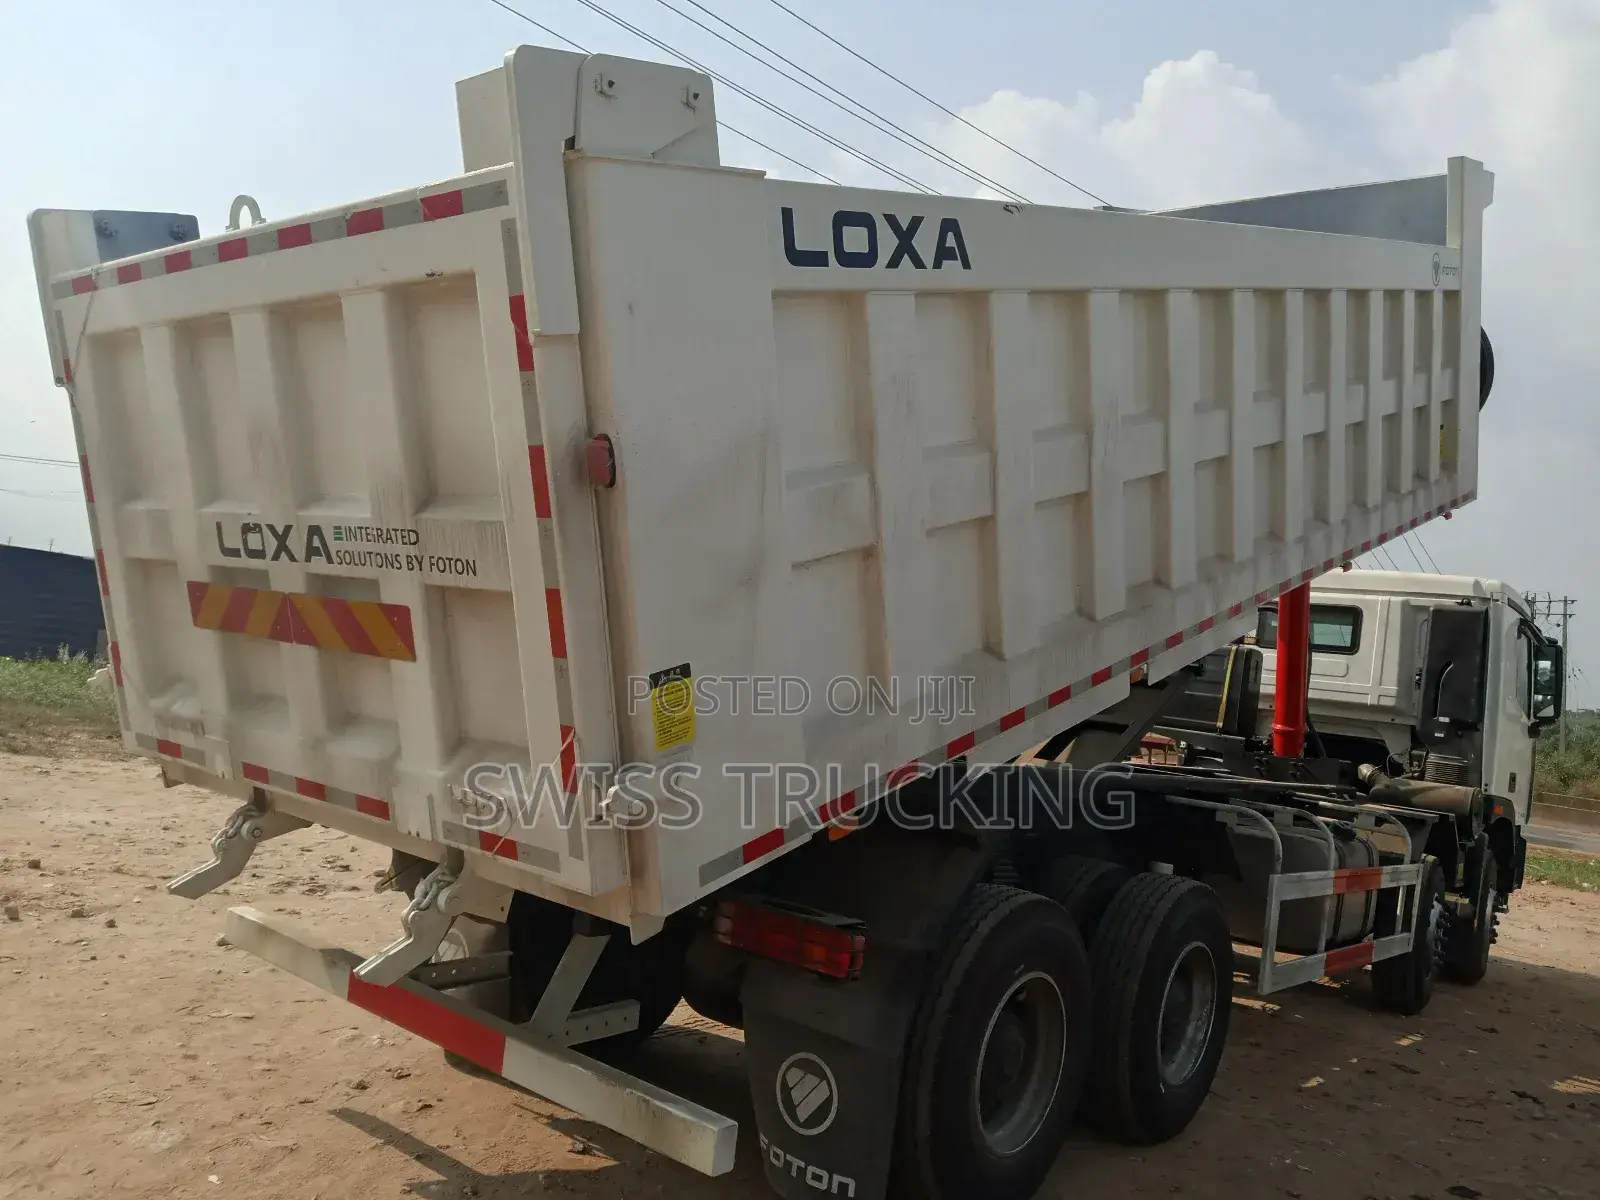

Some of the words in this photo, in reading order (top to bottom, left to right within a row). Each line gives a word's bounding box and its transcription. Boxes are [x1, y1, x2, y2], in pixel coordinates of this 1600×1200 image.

[781, 206, 972, 270] LOXA
[215, 521, 334, 565] LOXA
[406, 554, 424, 572] BY
[429, 555, 477, 577] FOTON
